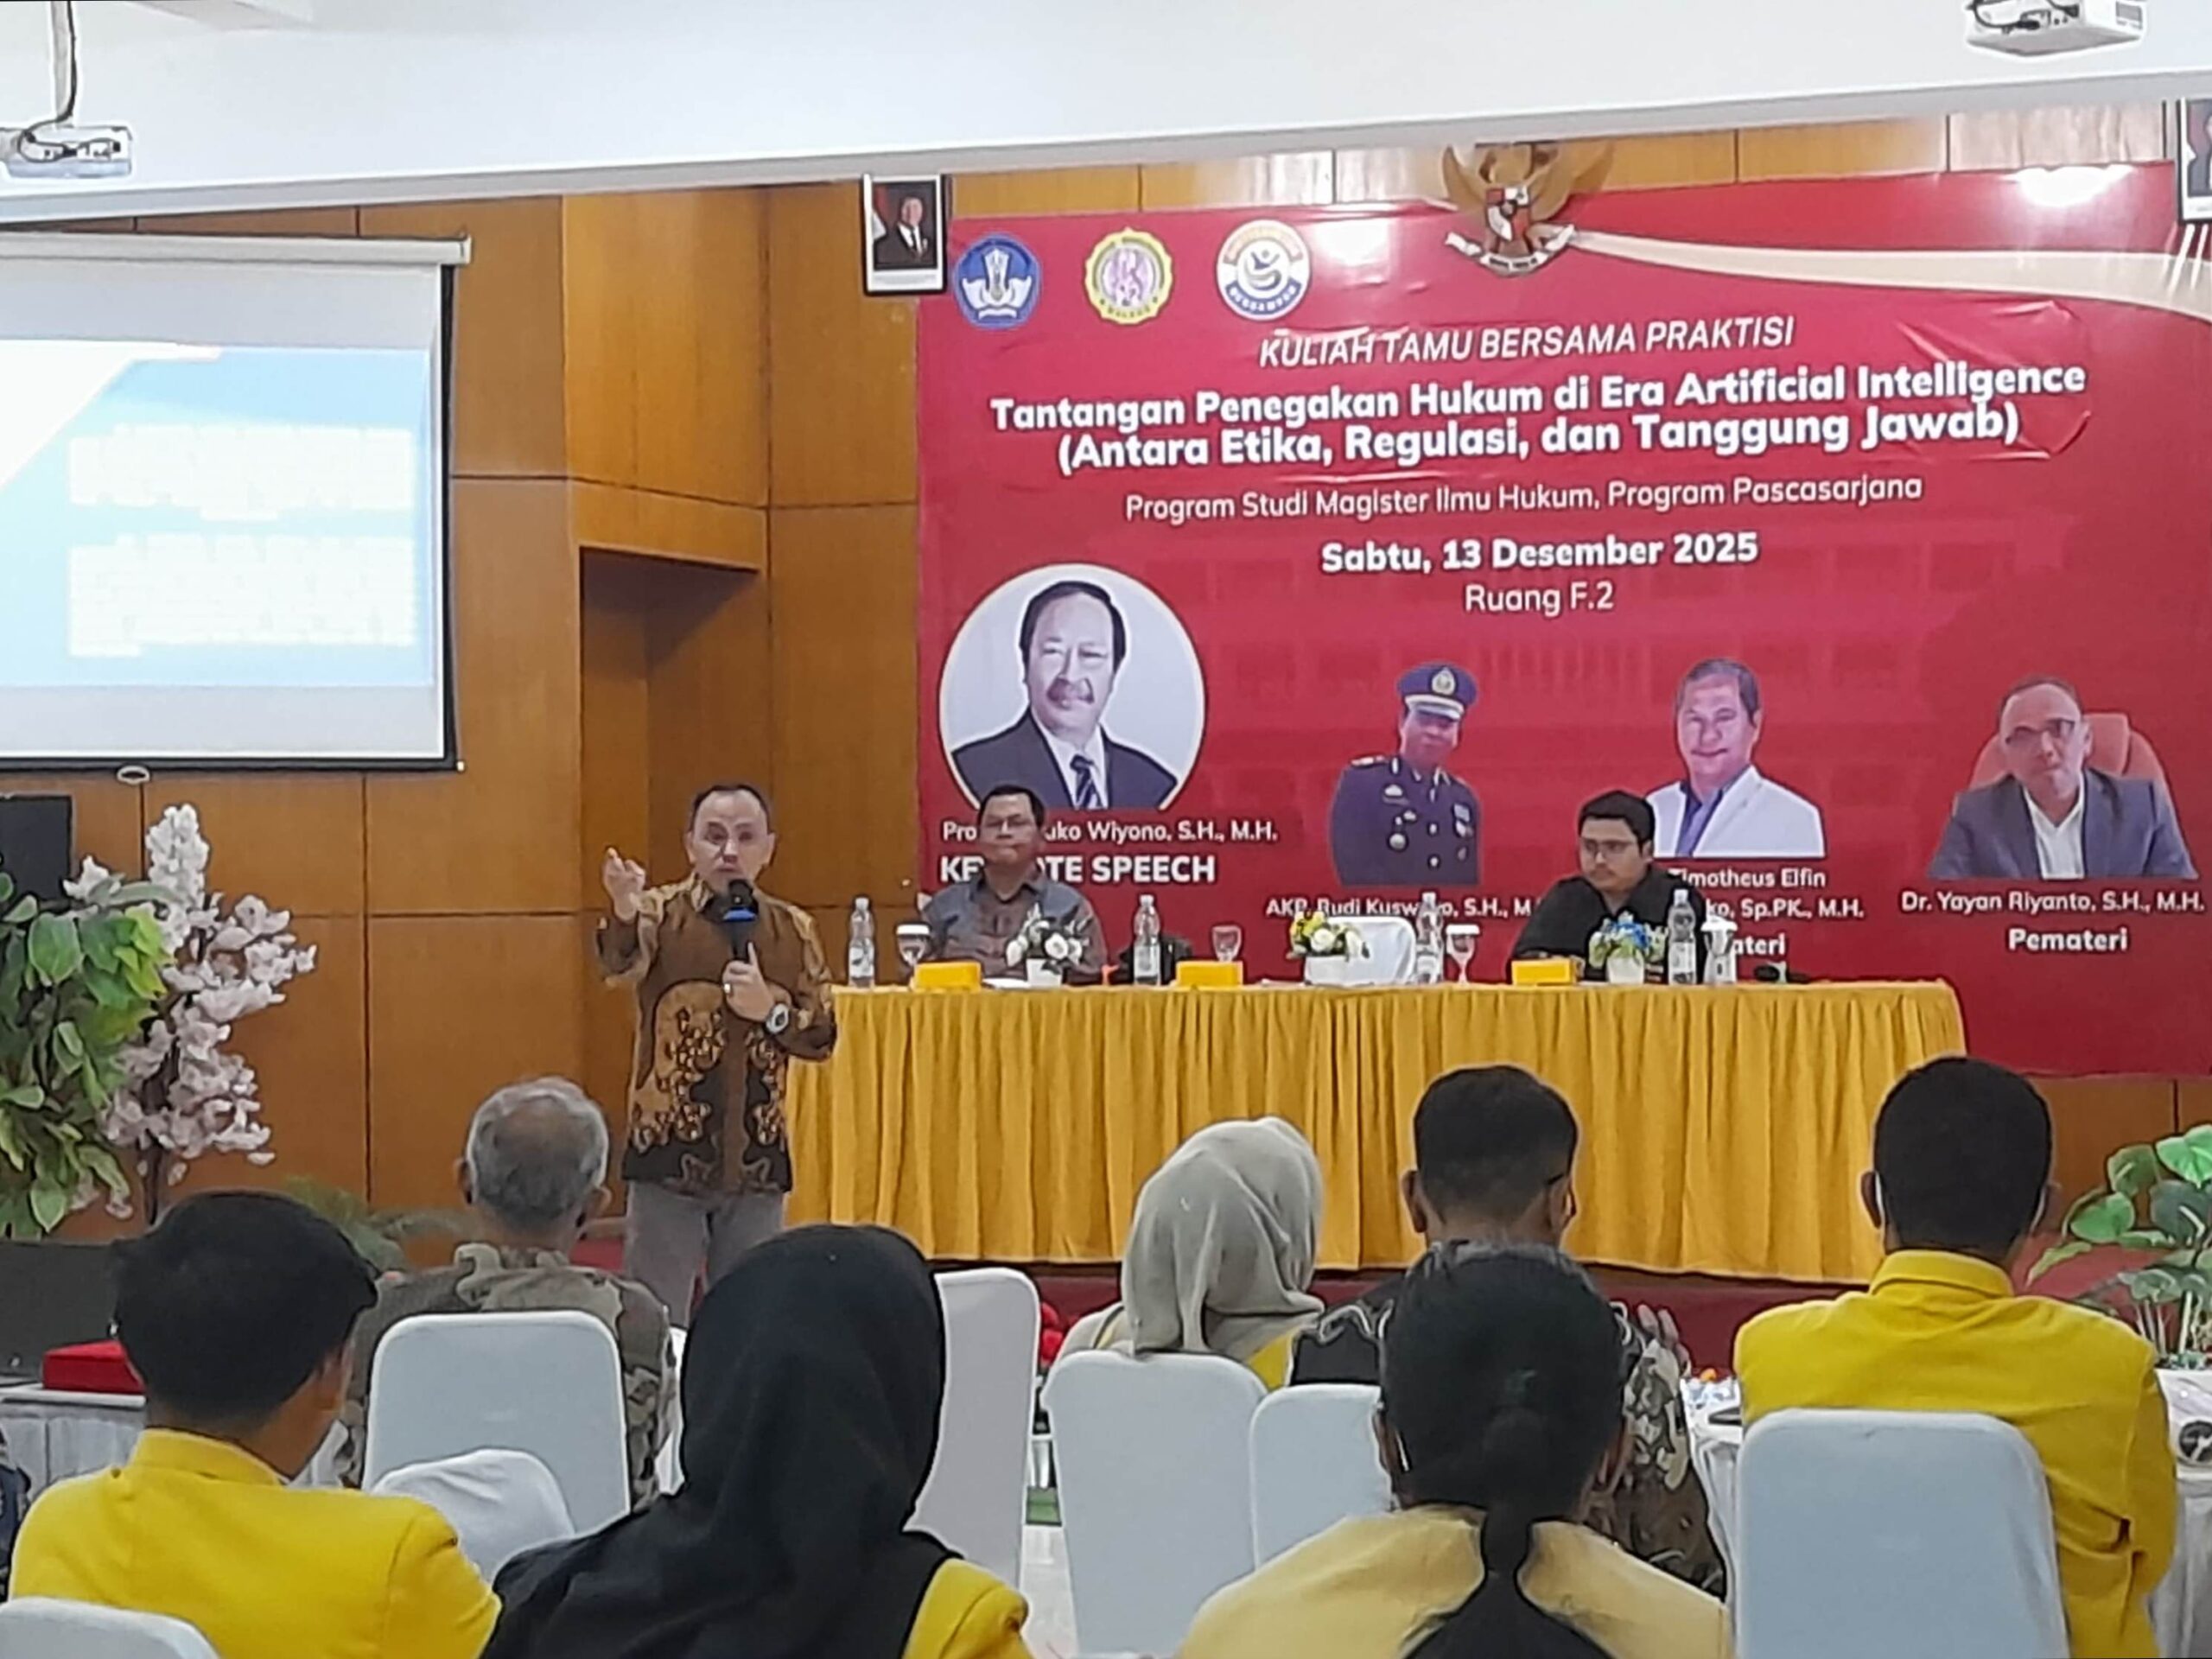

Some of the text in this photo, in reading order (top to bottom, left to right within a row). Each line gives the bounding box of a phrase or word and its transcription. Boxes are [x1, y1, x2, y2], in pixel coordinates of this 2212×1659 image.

[1260, 315, 1794, 367] KULIAH TAMU BERSAMA PRAKTISI
[990, 362, 2086, 433] Tantangan Penegakan Hukum di Era Artificial Intelligence
[1058, 400, 2018, 475] (Antara Etika, Regulasi, dan Tanggung Jawab)
[1126, 474, 1923, 525] Program Studi Magister Ilmu Hukum, Program Pascasarjana
[1322, 531, 1758, 574] Sabtu, 13 Desember 2025
[1465, 581, 1614, 617] Ruang F.2
[943, 821, 977, 841] Pro
[1044, 820, 1082, 841] uko
[1230, 820, 1278, 841] M.H.
[940, 855, 1215, 882] KETE SPEECH
[1781, 868, 1826, 887] Elfin
[1818, 899, 1864, 918] M.H.
[1902, 891, 2204, 914] Dr. Yayan Riyanto, S.H., M.H.
[1732, 933, 1786, 955] ateri
[2009, 927, 2127, 950] Pemateri
